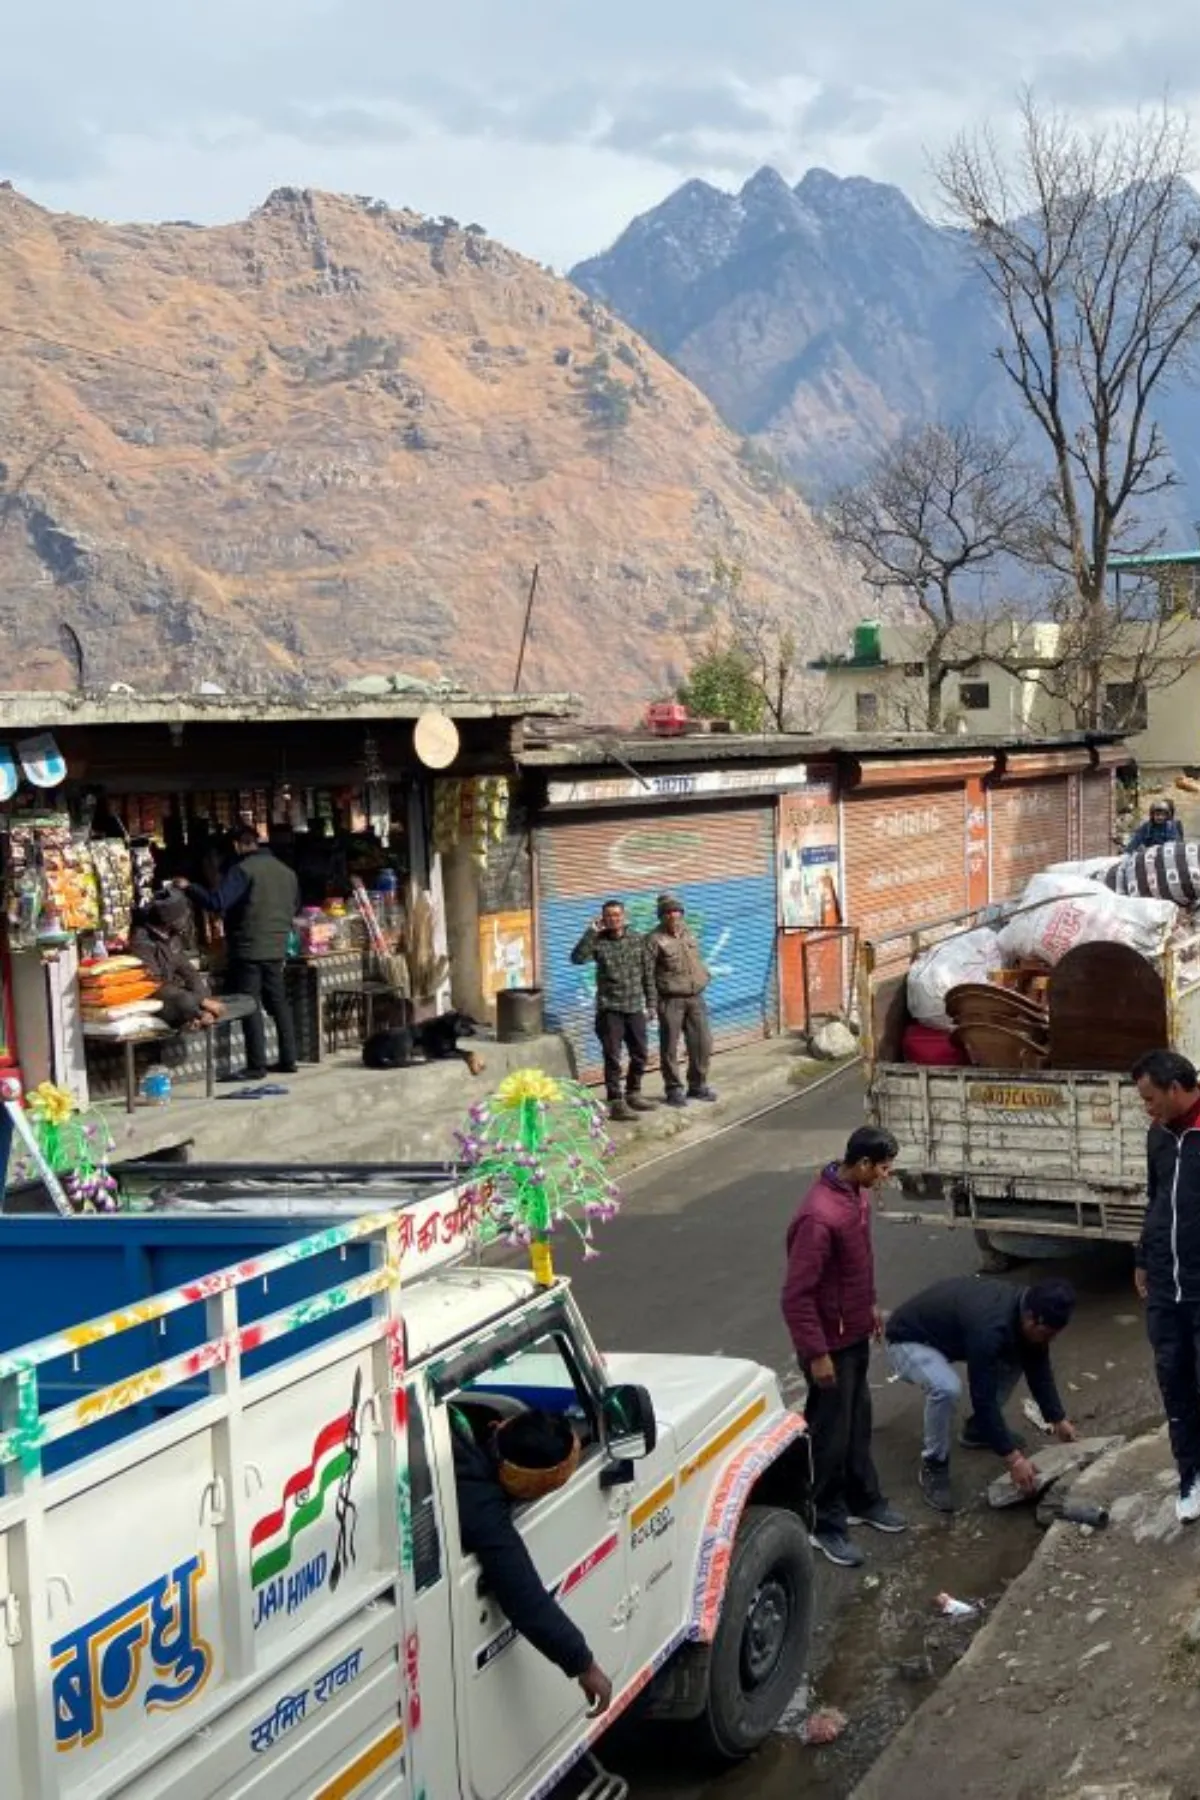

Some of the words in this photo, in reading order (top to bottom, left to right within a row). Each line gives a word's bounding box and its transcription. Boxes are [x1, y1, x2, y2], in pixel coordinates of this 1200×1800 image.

[253, 1576, 284, 1631] JAI
[287, 1551, 328, 1616] HIND
[49, 1549, 213, 1752] बन्धु
[250, 1689, 311, 1753] सुमित
[314, 1648, 364, 1704] रावत
